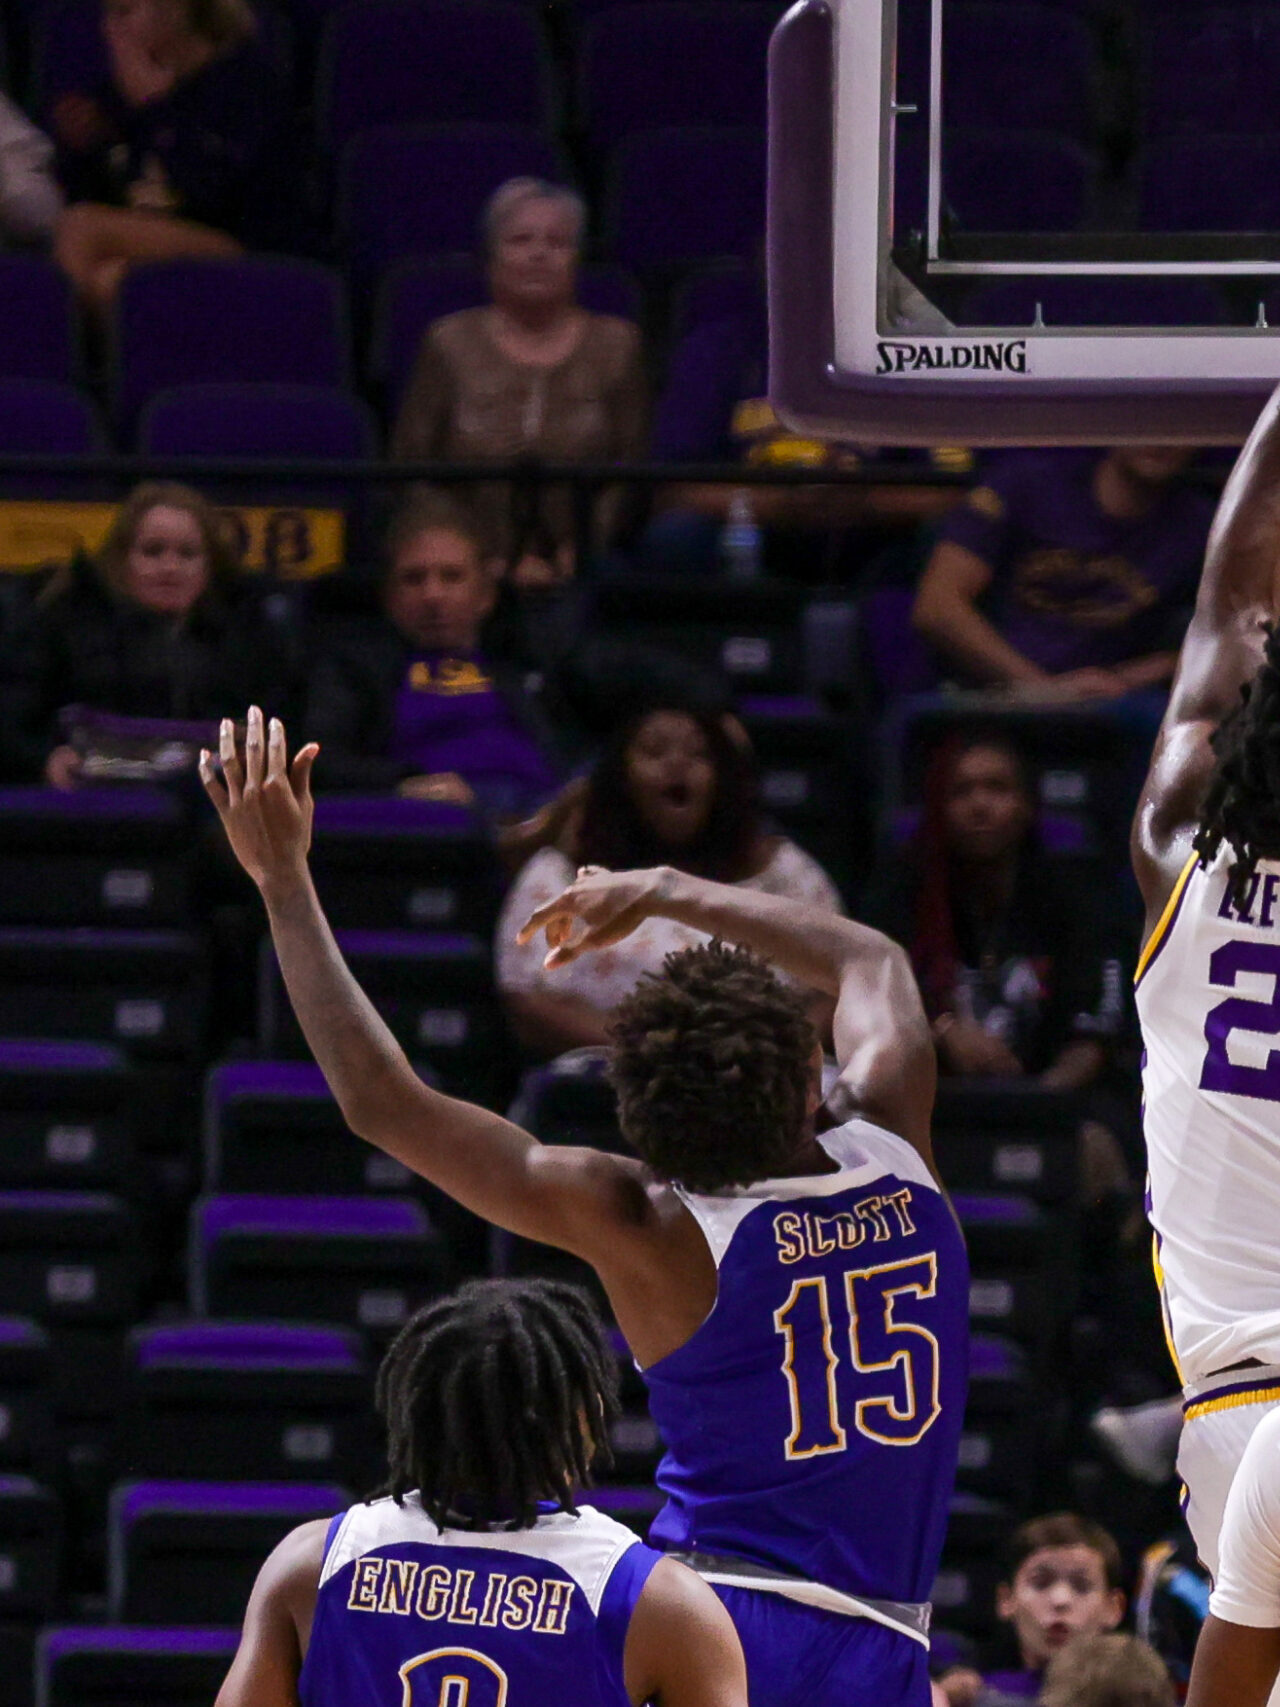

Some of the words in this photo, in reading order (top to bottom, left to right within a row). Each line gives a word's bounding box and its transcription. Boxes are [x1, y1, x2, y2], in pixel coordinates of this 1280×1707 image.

[876, 340, 1026, 375] SPALDING
[772, 1187, 917, 1264] SCOTT
[772, 1251, 942, 1461] 15
[346, 1557, 576, 1635] ENGLISH
